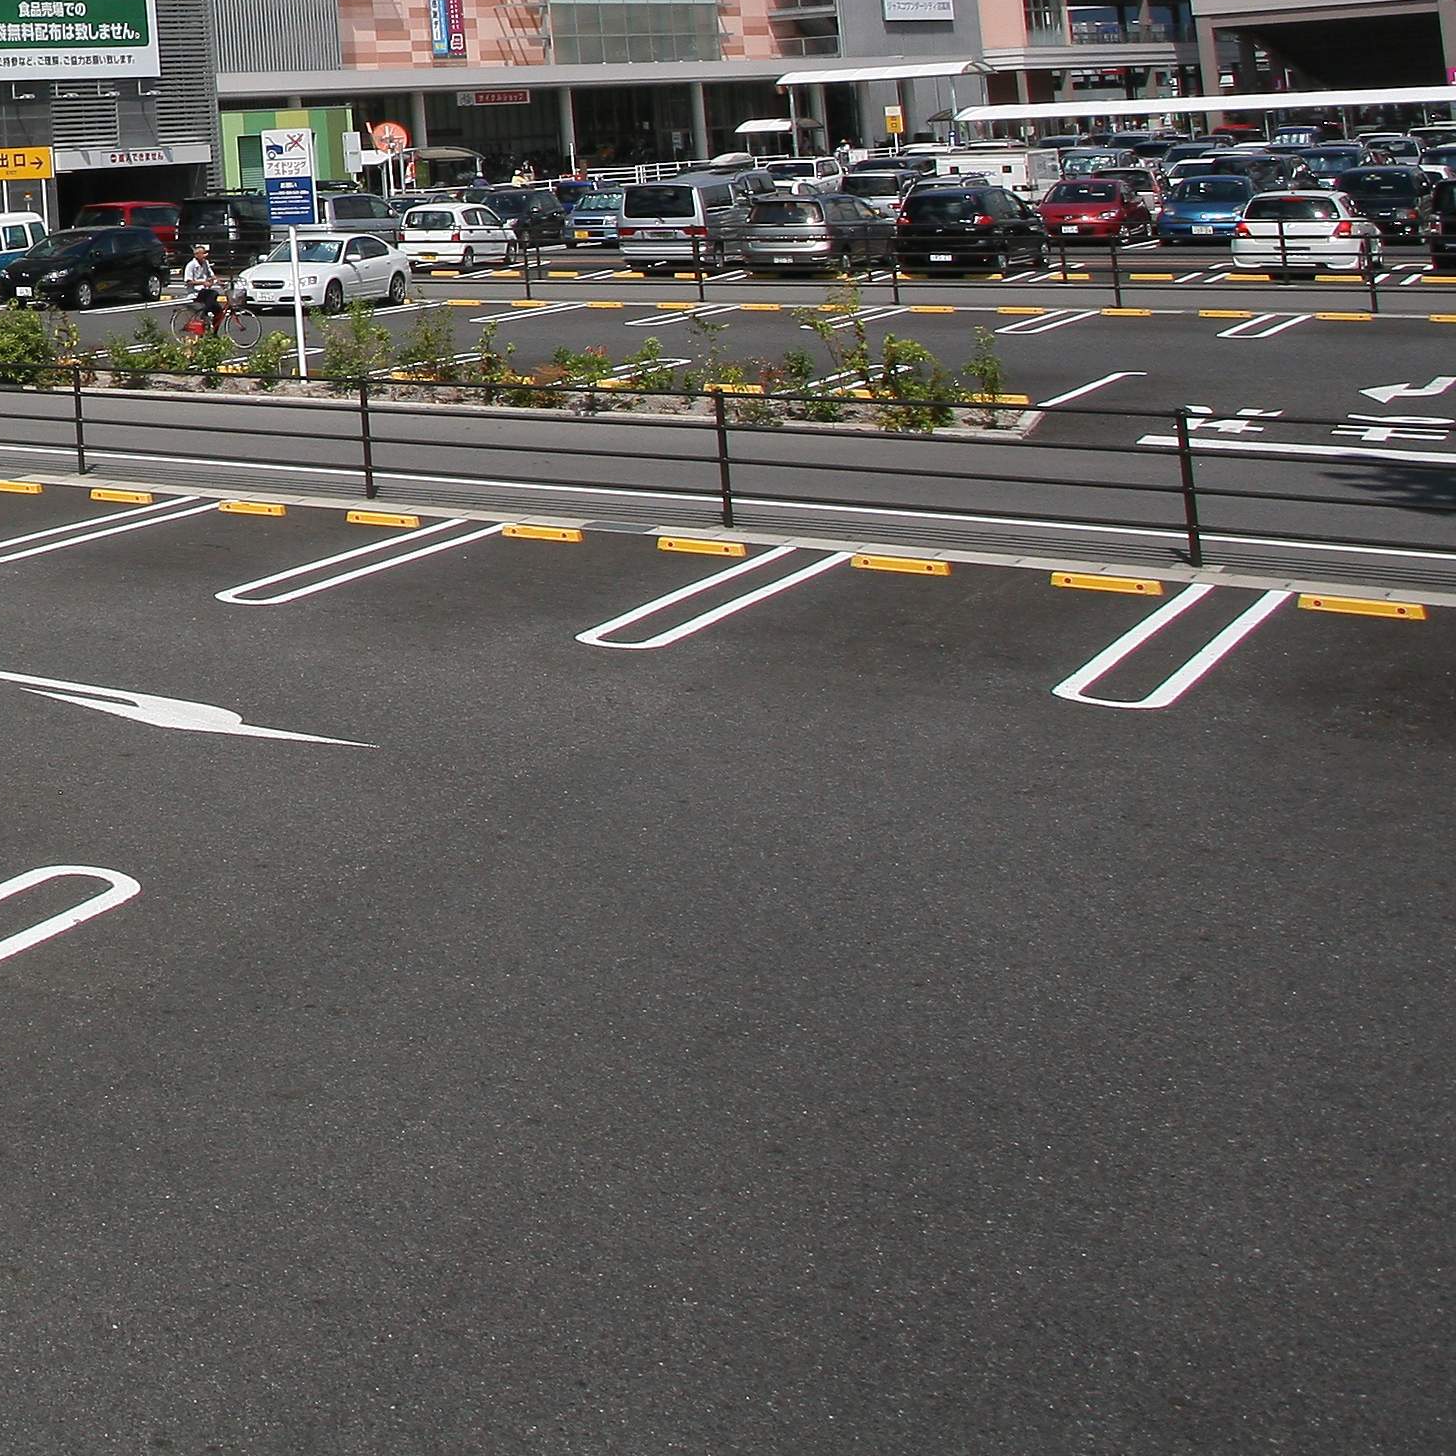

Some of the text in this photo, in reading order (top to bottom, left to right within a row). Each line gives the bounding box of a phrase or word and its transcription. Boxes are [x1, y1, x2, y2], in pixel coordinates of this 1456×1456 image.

[18, 1, 86, 18] 食品売場での
